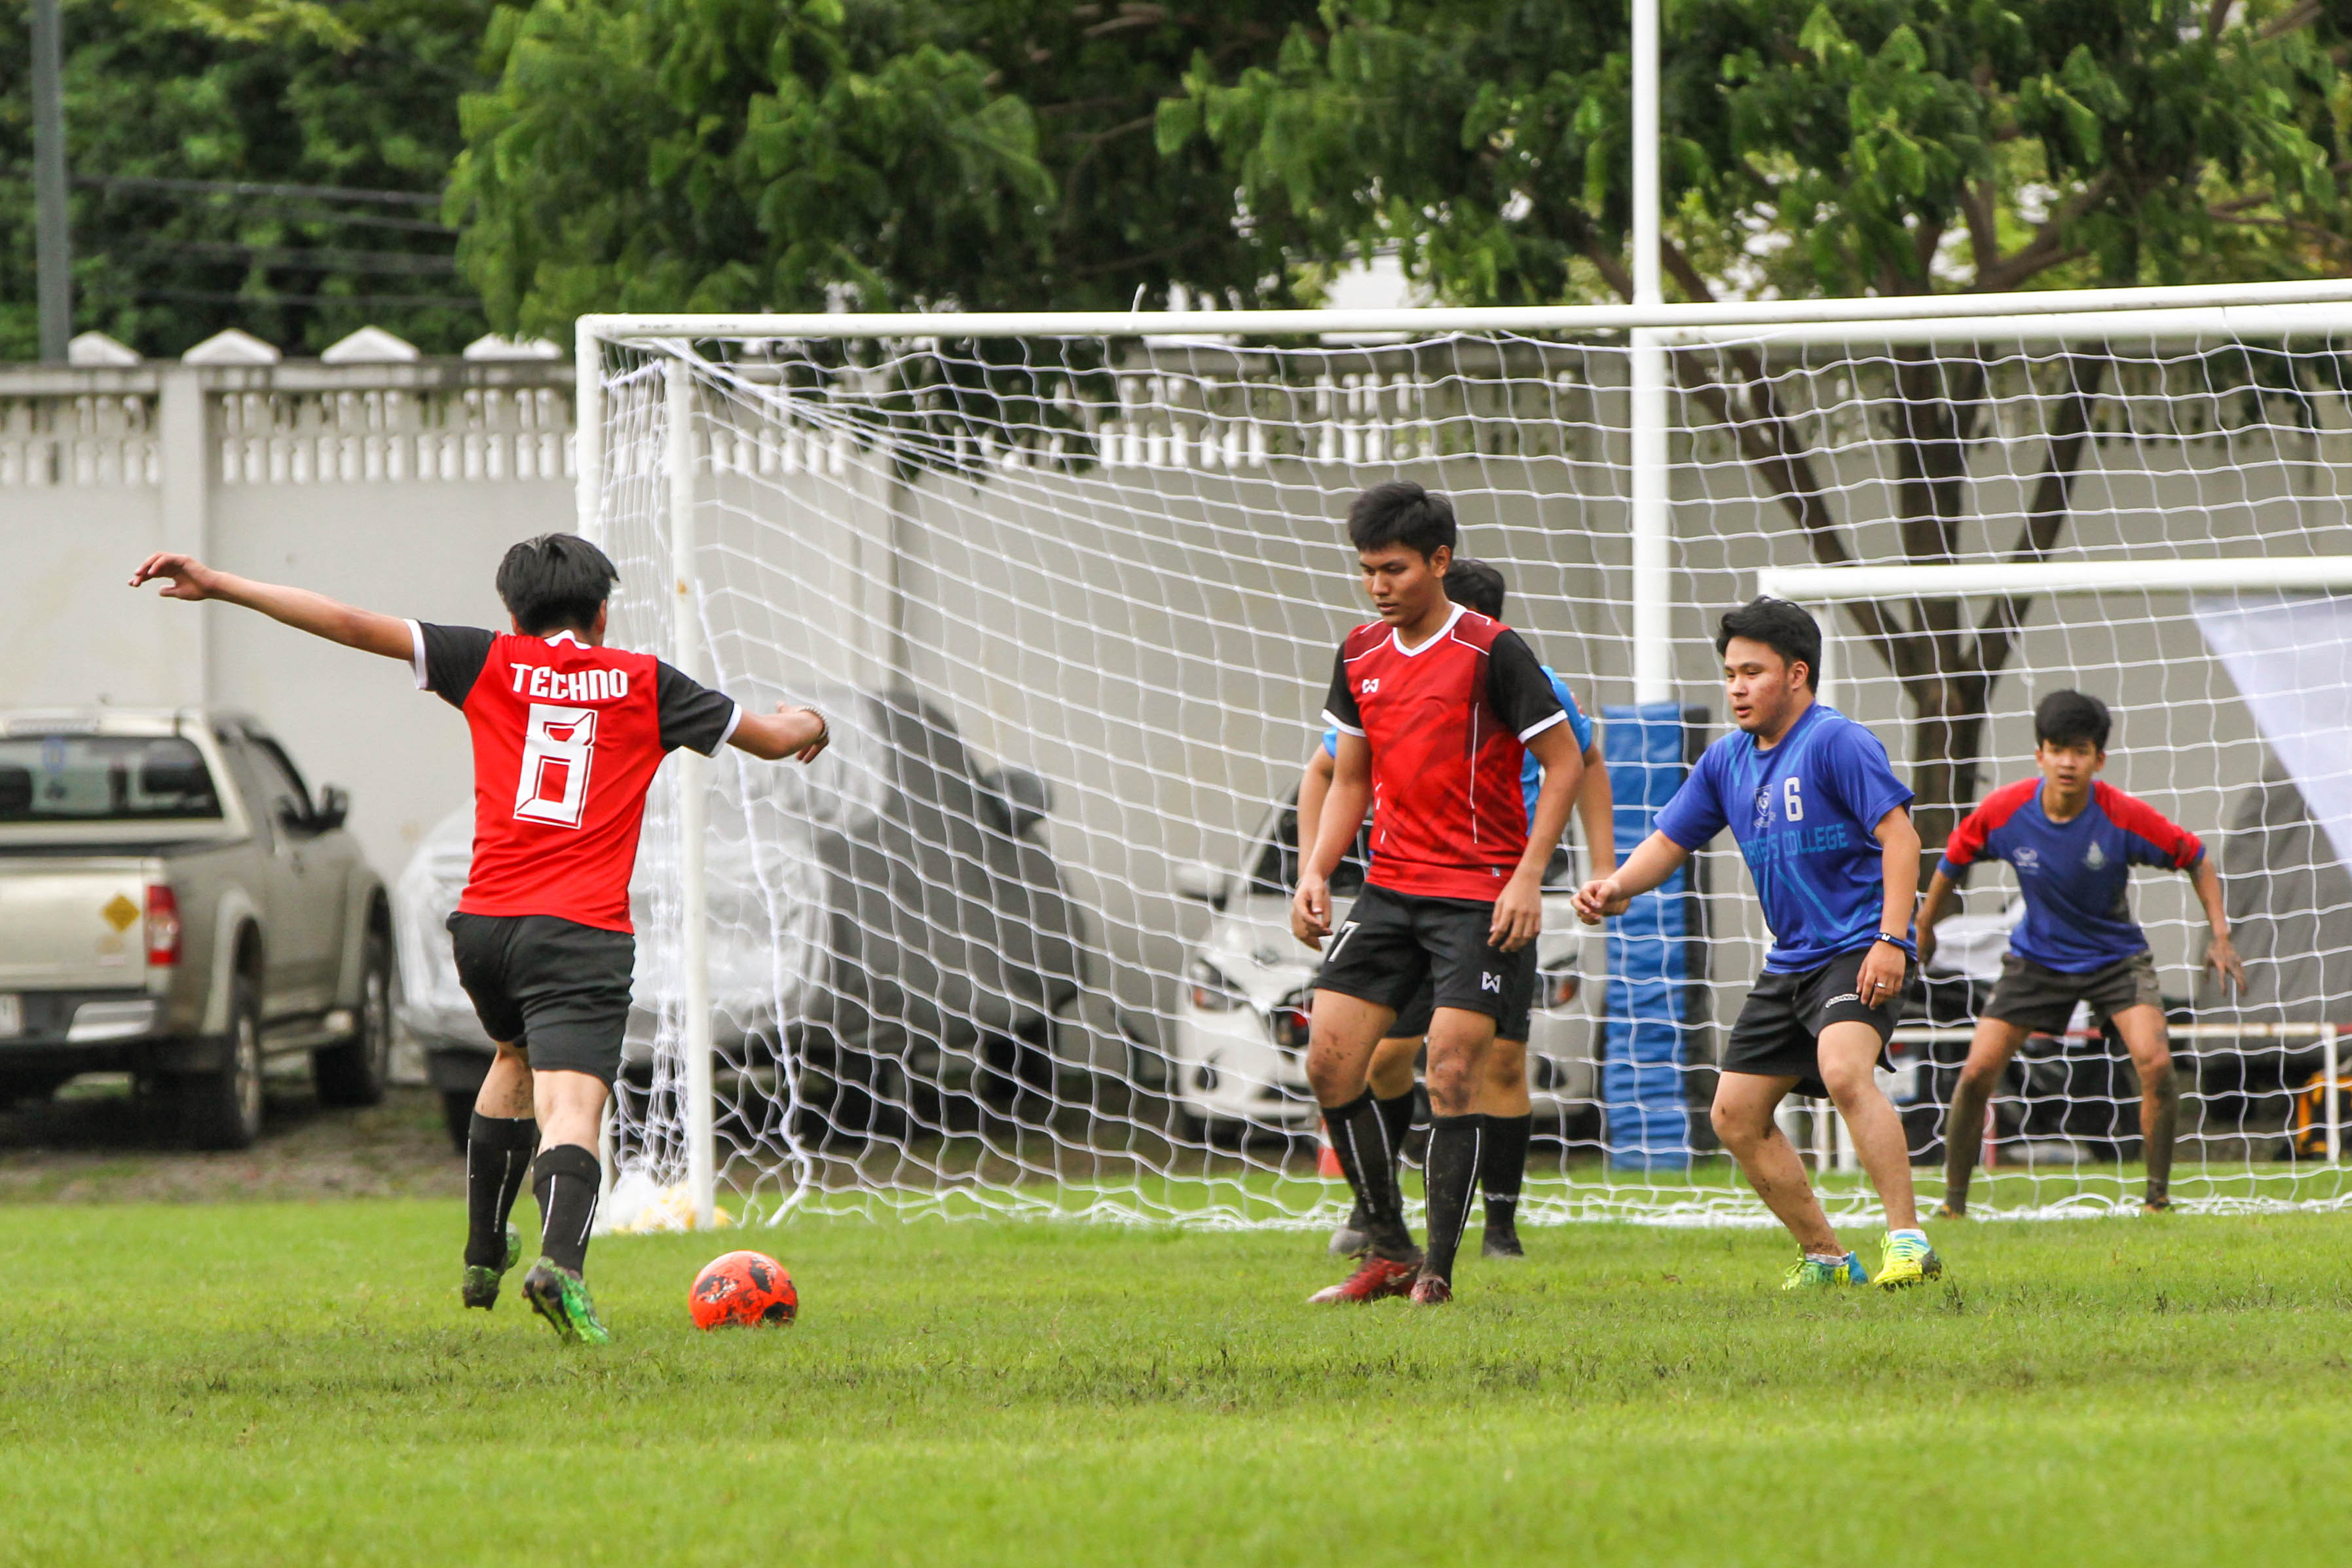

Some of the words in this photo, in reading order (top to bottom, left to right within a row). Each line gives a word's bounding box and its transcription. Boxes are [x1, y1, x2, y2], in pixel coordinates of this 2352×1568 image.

[510, 662, 629, 701] TECHNO
[513, 702, 598, 830] 8
[1783, 776, 1804, 822] 6
[1328, 920, 1361, 962] 7
